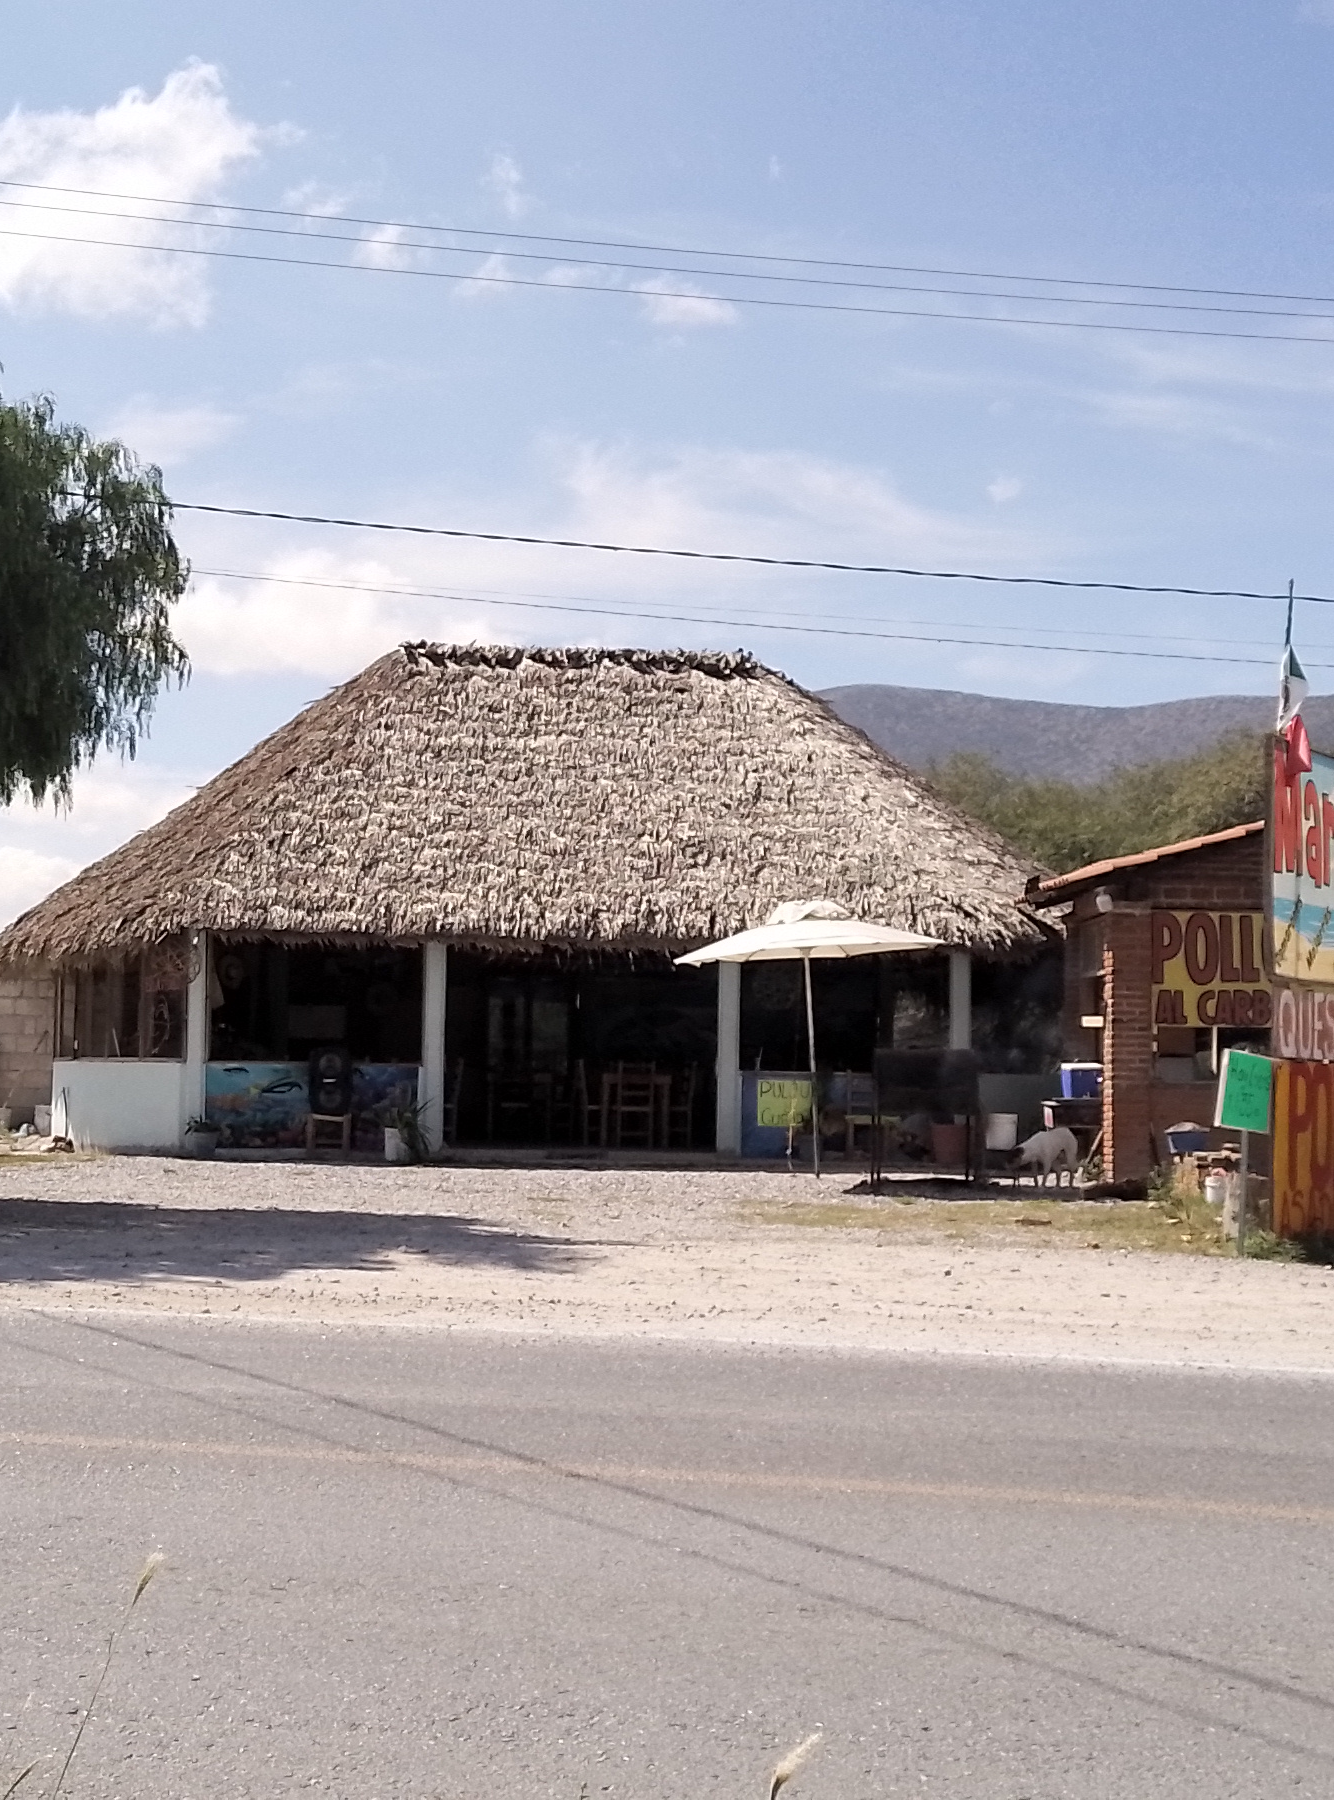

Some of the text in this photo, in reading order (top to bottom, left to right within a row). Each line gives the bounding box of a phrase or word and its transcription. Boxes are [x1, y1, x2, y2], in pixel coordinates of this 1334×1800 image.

[1152, 912, 1270, 985] POLL
[1156, 989, 1271, 1026] AL CARB
